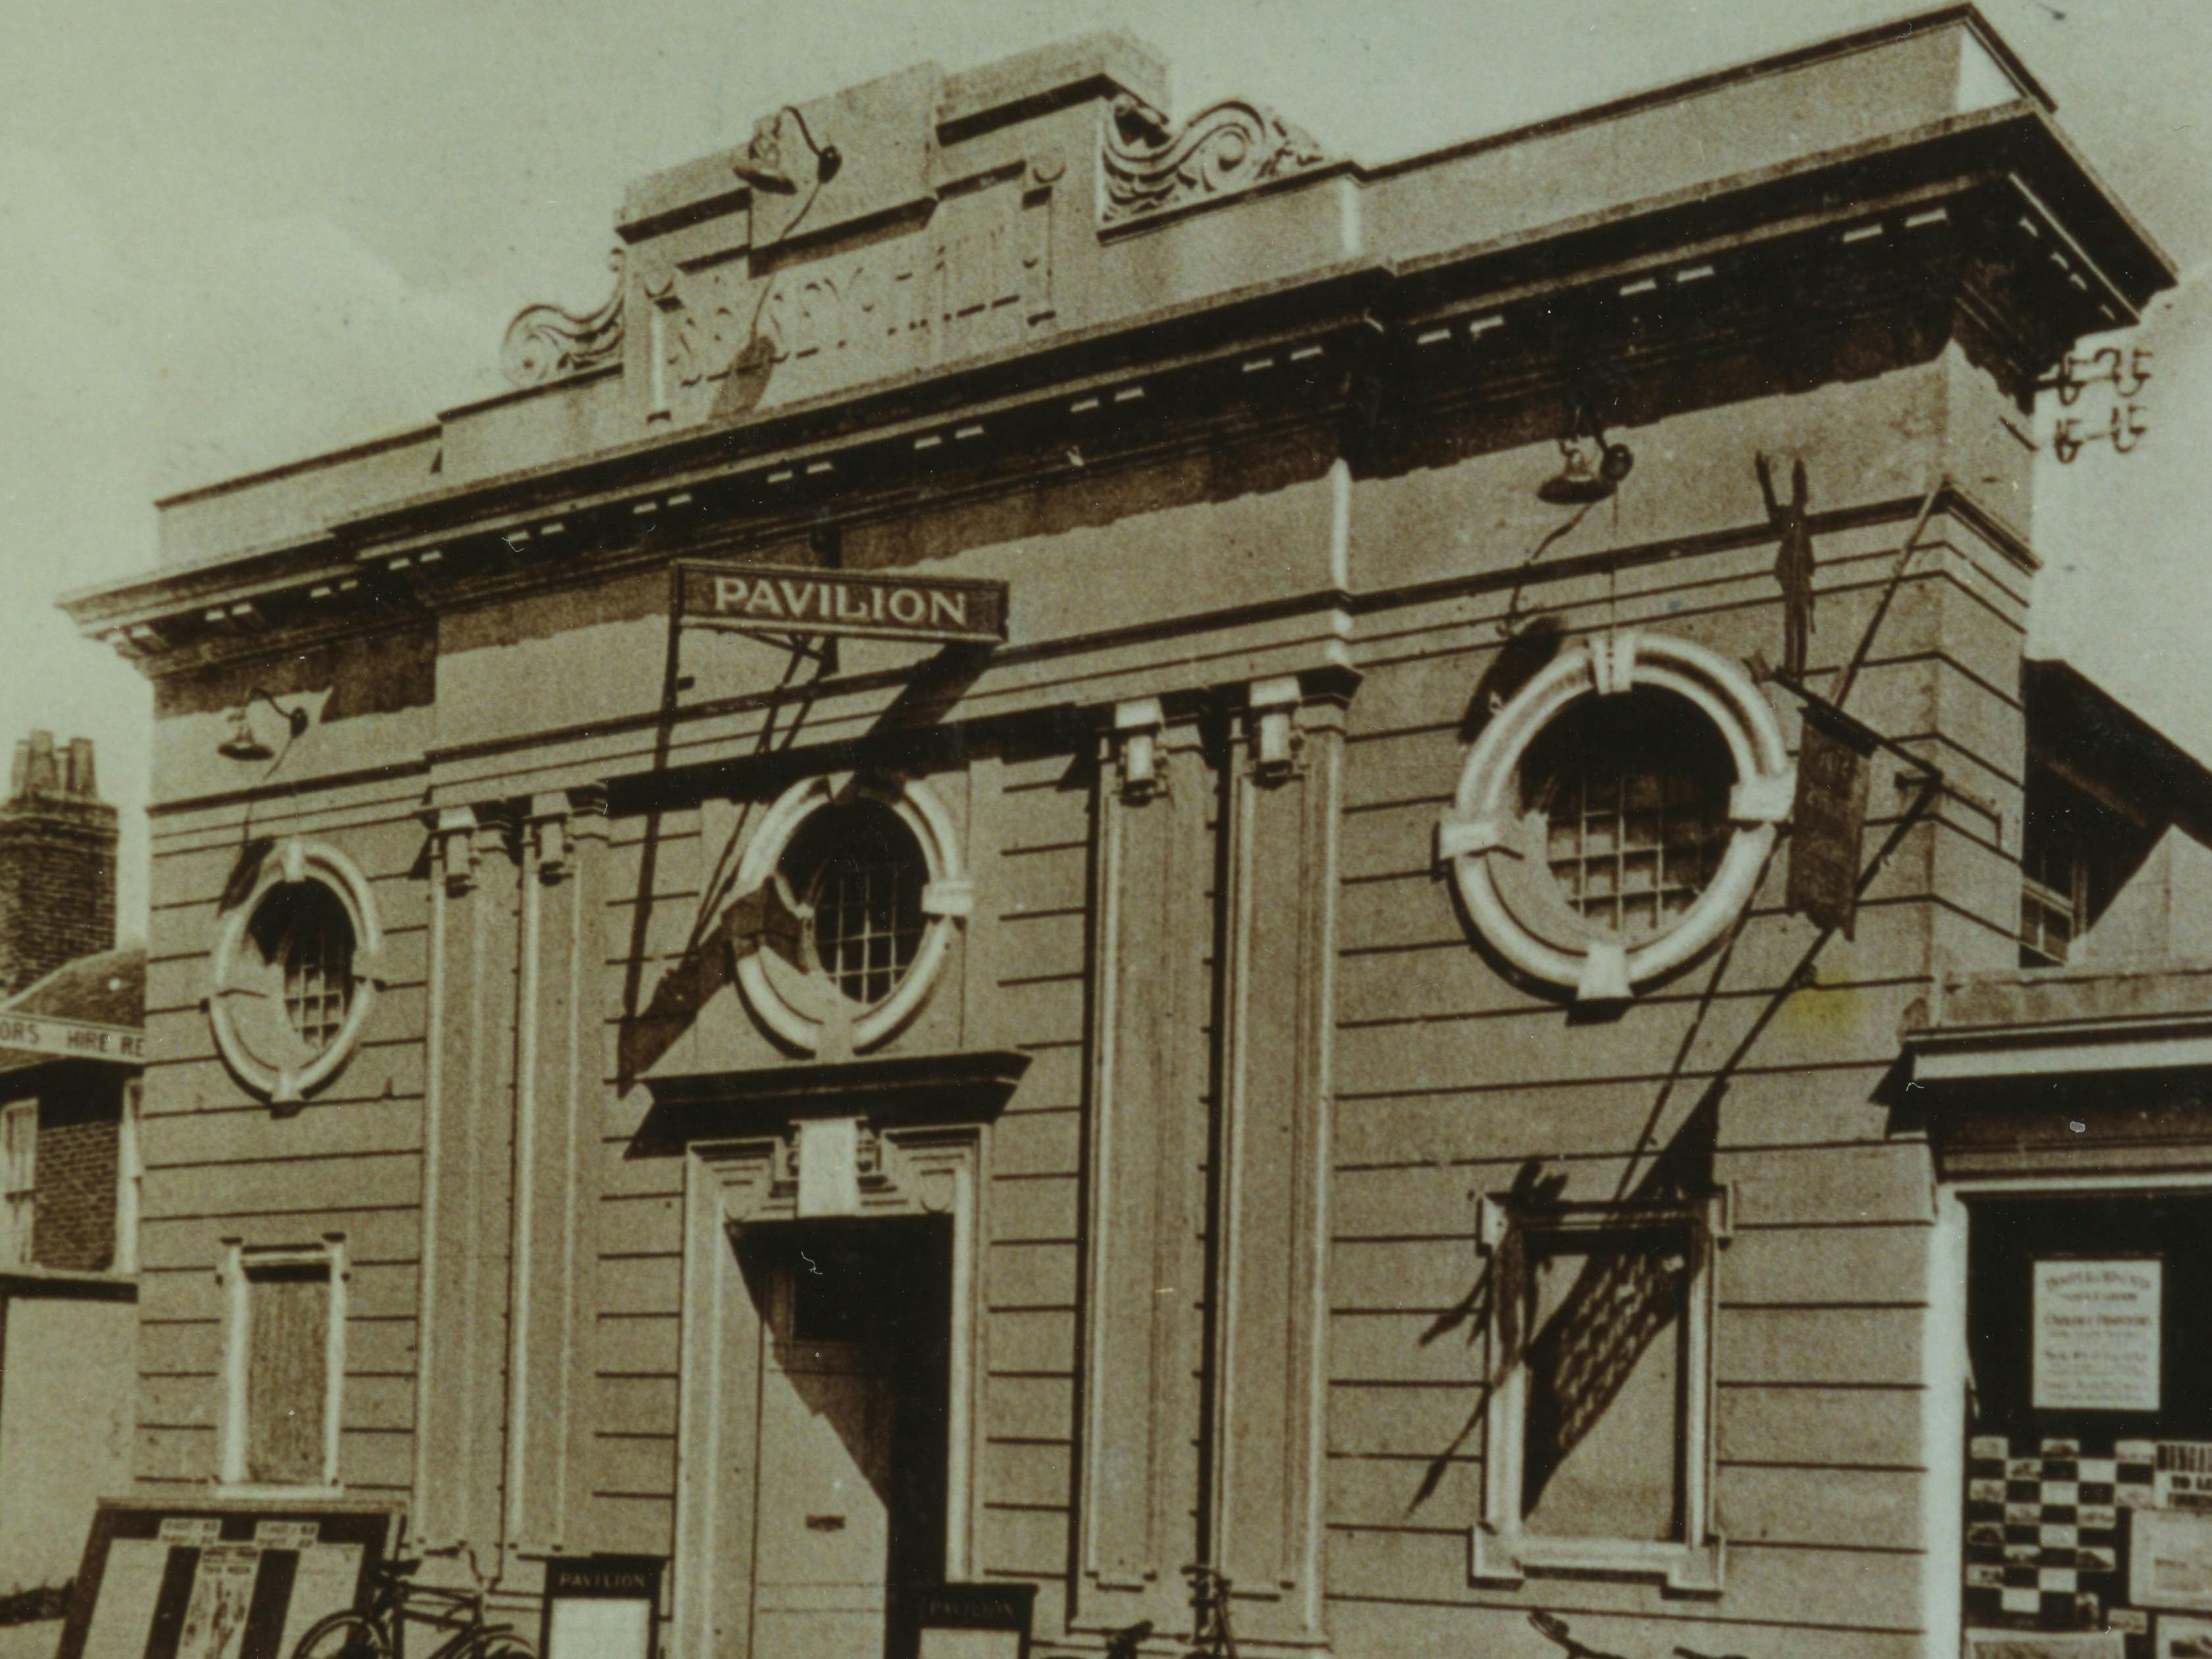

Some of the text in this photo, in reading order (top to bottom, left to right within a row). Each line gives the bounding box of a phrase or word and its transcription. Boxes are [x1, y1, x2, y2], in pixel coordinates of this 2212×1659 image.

[715, 576, 967, 625] PAVILION
[68, 1031, 109, 1052] HIRE
[559, 1571, 645, 1589] PAVILION
